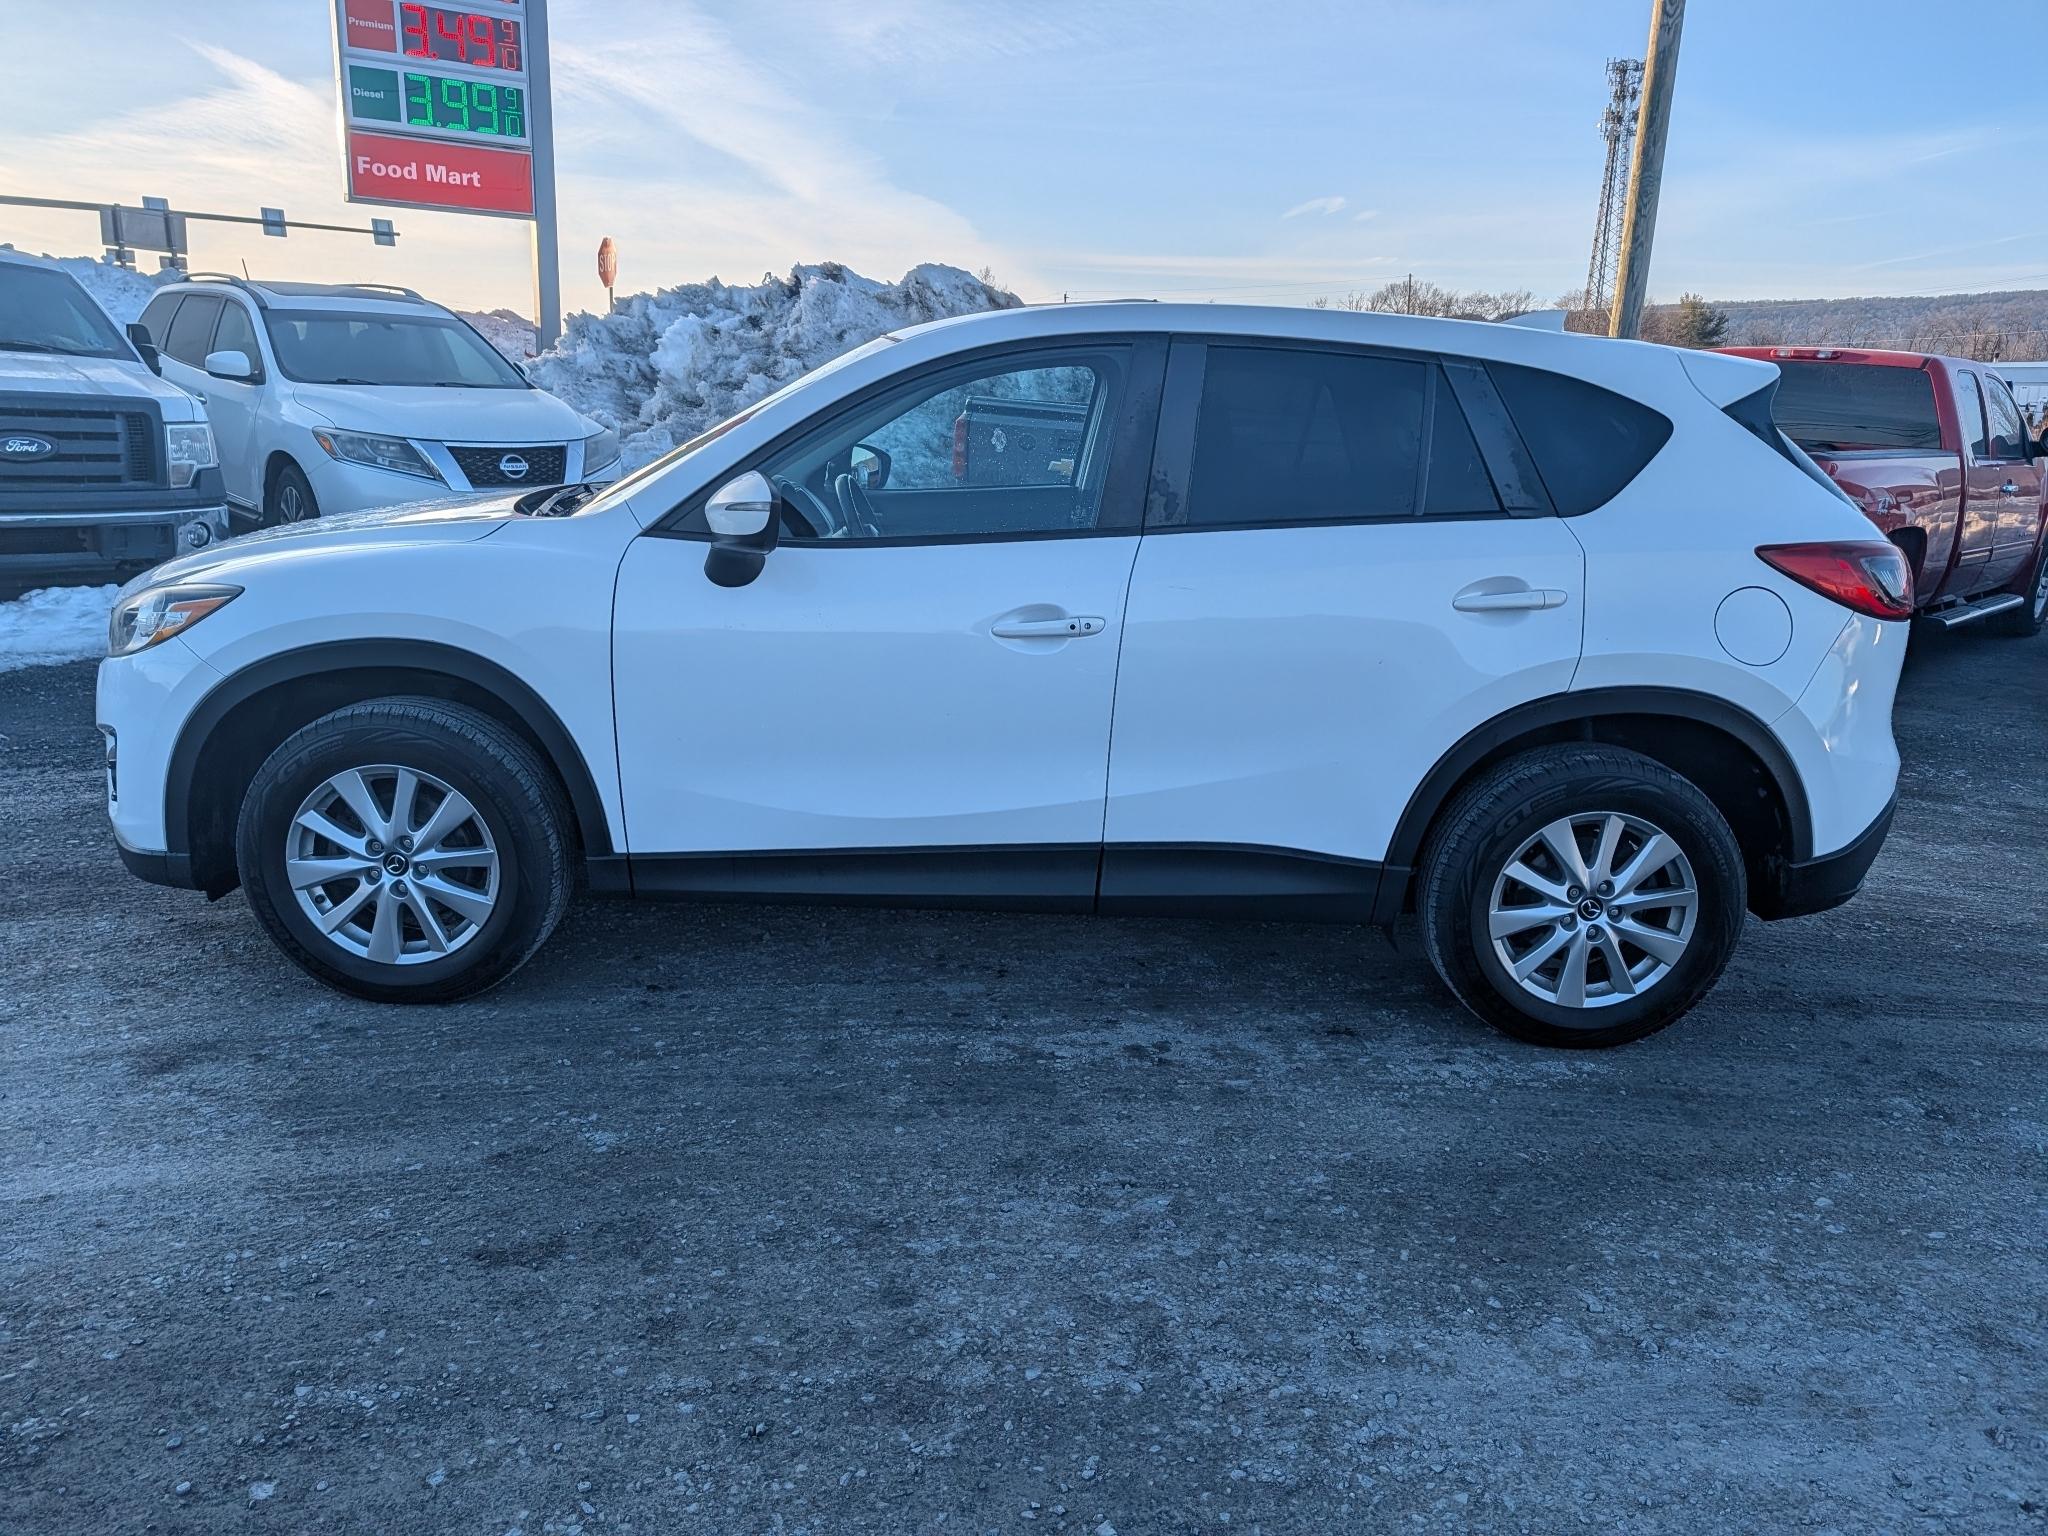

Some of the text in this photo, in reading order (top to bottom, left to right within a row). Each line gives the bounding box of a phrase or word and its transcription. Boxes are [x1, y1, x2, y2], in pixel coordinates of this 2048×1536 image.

[348, 16, 394, 31] Premium
[402, 3, 497, 67] 3.49
[353, 87, 384, 100] Diesel
[405, 73, 499, 136] 3.99
[356, 156, 481, 187] Food Mart
[600, 253, 616, 272] STOP
[6, 439, 38, 452] Ford
